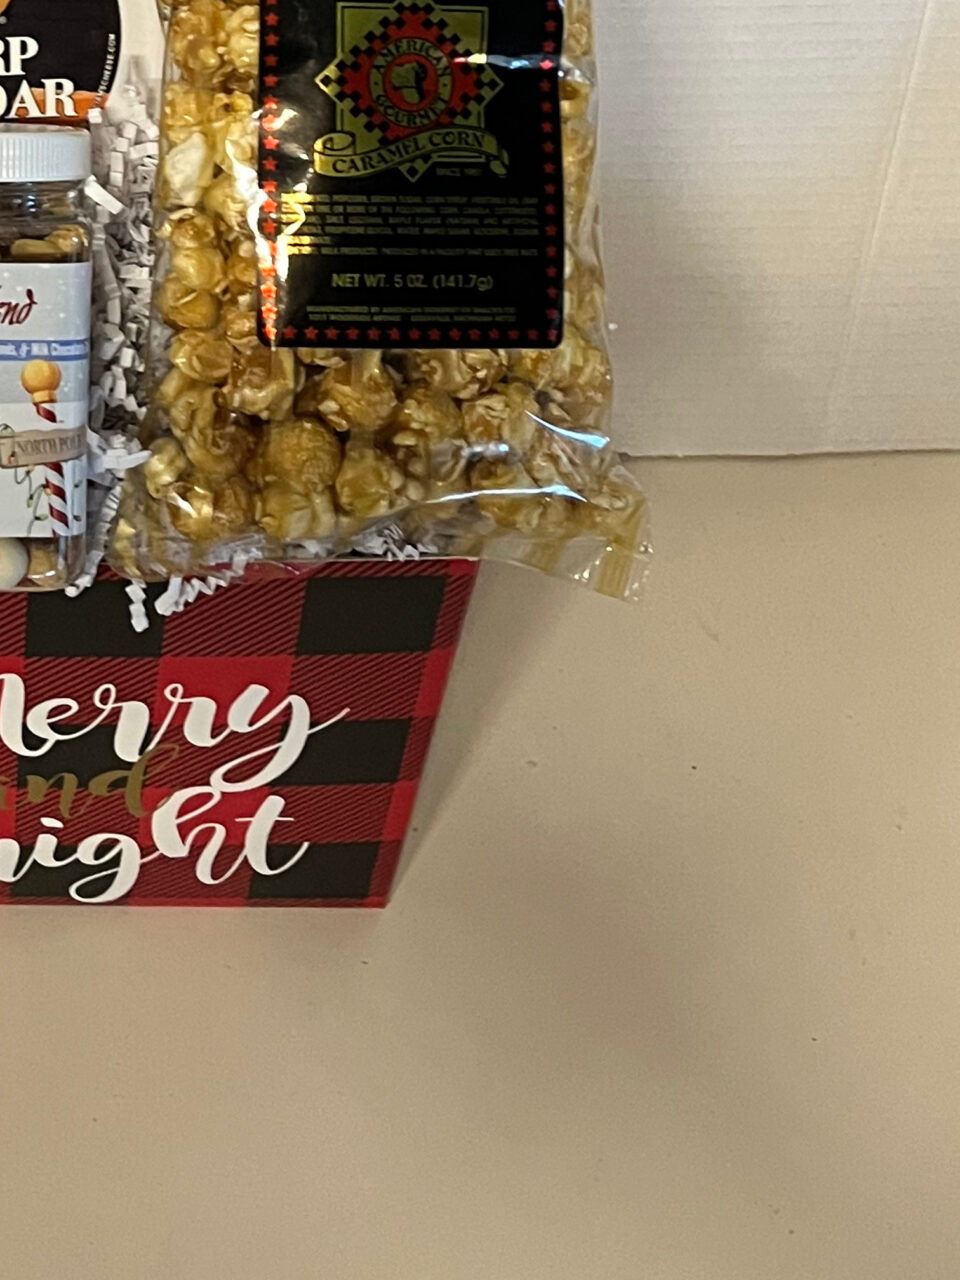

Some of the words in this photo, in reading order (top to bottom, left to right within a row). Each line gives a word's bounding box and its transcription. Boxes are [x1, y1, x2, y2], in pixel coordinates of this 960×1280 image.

[374, 39, 451, 77] AMERICAN
[332, 137, 427, 173] CARAMEL
[429, 131, 486, 148] CORN
[331, 274, 360, 287] NET
[364, 274, 389, 287] WT.
[394, 274, 403, 287] 5
[432, 274, 494, 291] (141.7g)
